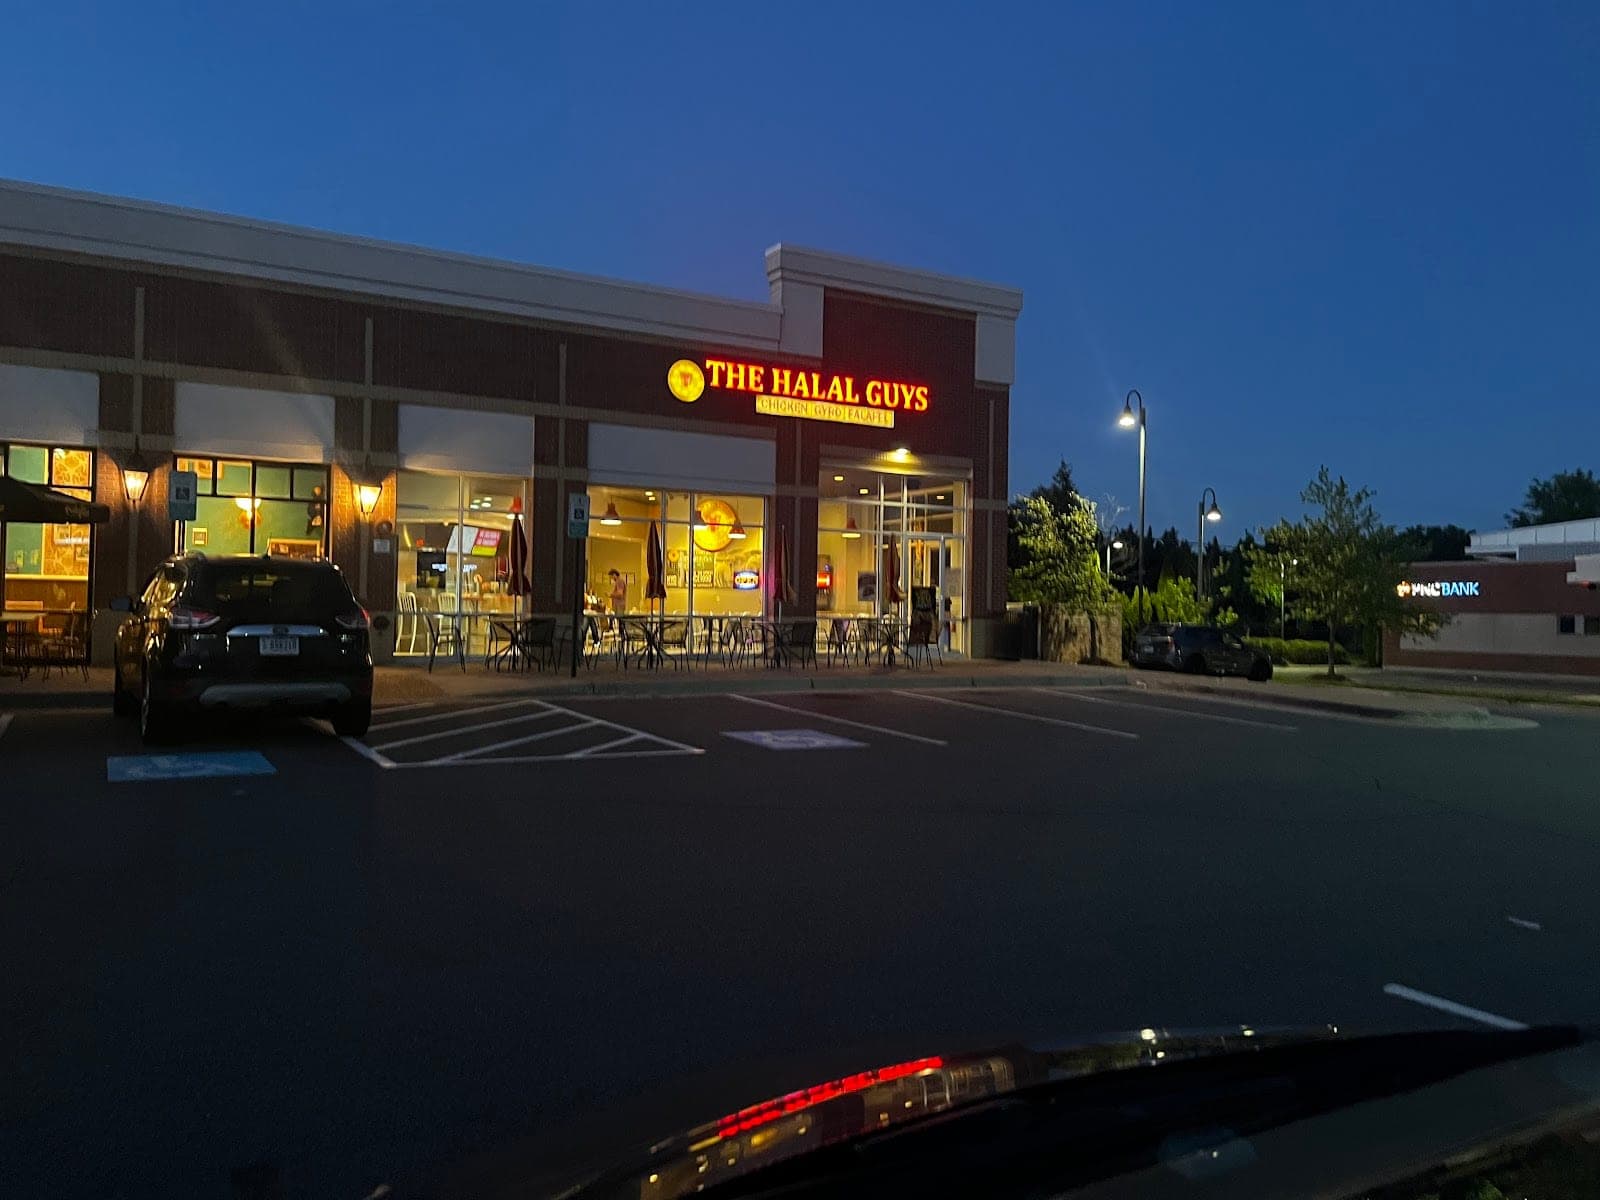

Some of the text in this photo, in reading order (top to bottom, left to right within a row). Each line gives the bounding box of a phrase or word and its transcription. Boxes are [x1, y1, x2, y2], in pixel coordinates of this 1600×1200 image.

[706, 360, 929, 412] THE HALAL GUYS
[761, 399, 889, 424] CHICKEN GYRO FALAFEL
